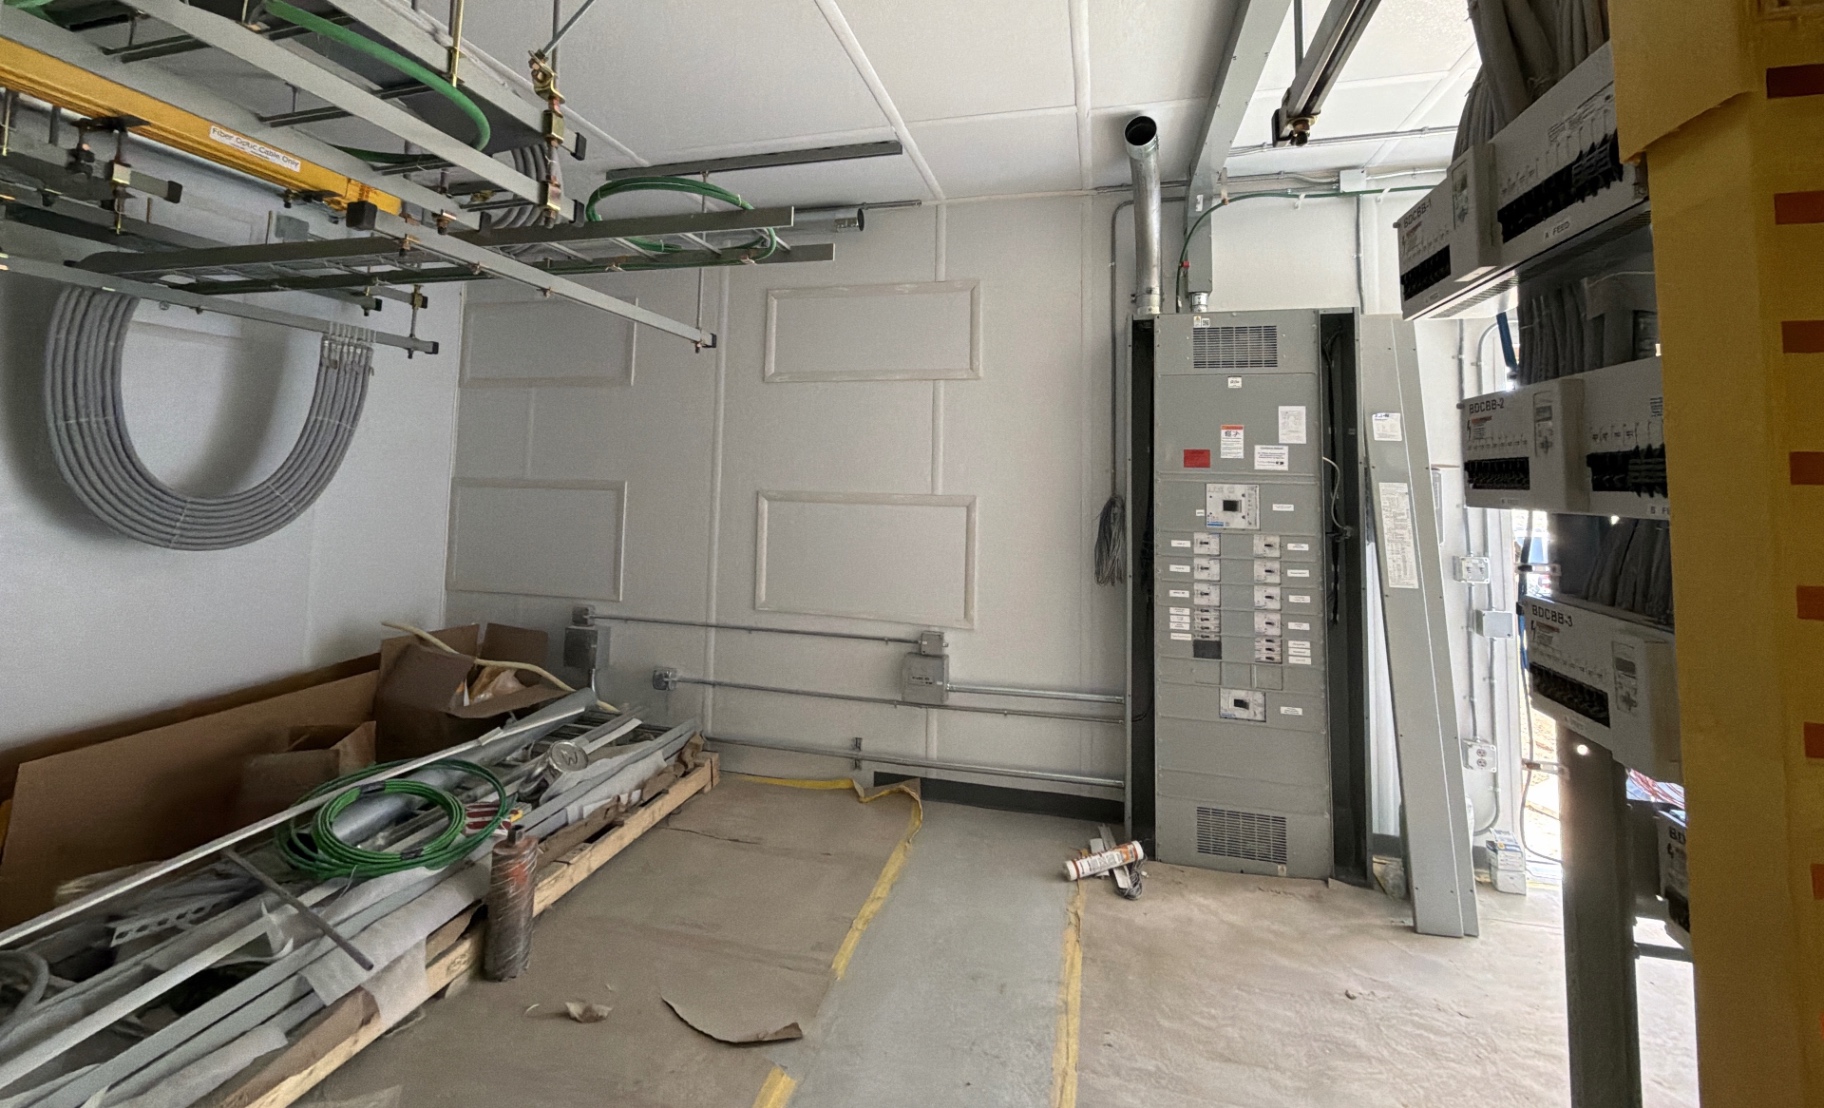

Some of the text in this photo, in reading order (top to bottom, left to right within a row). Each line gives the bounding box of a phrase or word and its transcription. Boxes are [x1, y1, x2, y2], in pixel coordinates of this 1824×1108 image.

[211, 127, 234, 141] Fiber
[235, 137, 258, 151] Optic
[258, 146, 280, 159] Cable
[281, 155, 300, 169] Only
[1403, 197, 1432, 229] BDCBB-1
[1552, 220, 1570, 236] FEED
[1469, 397, 1504, 414] BDCBB-2
[1531, 604, 1573, 628] BDCBB-3
